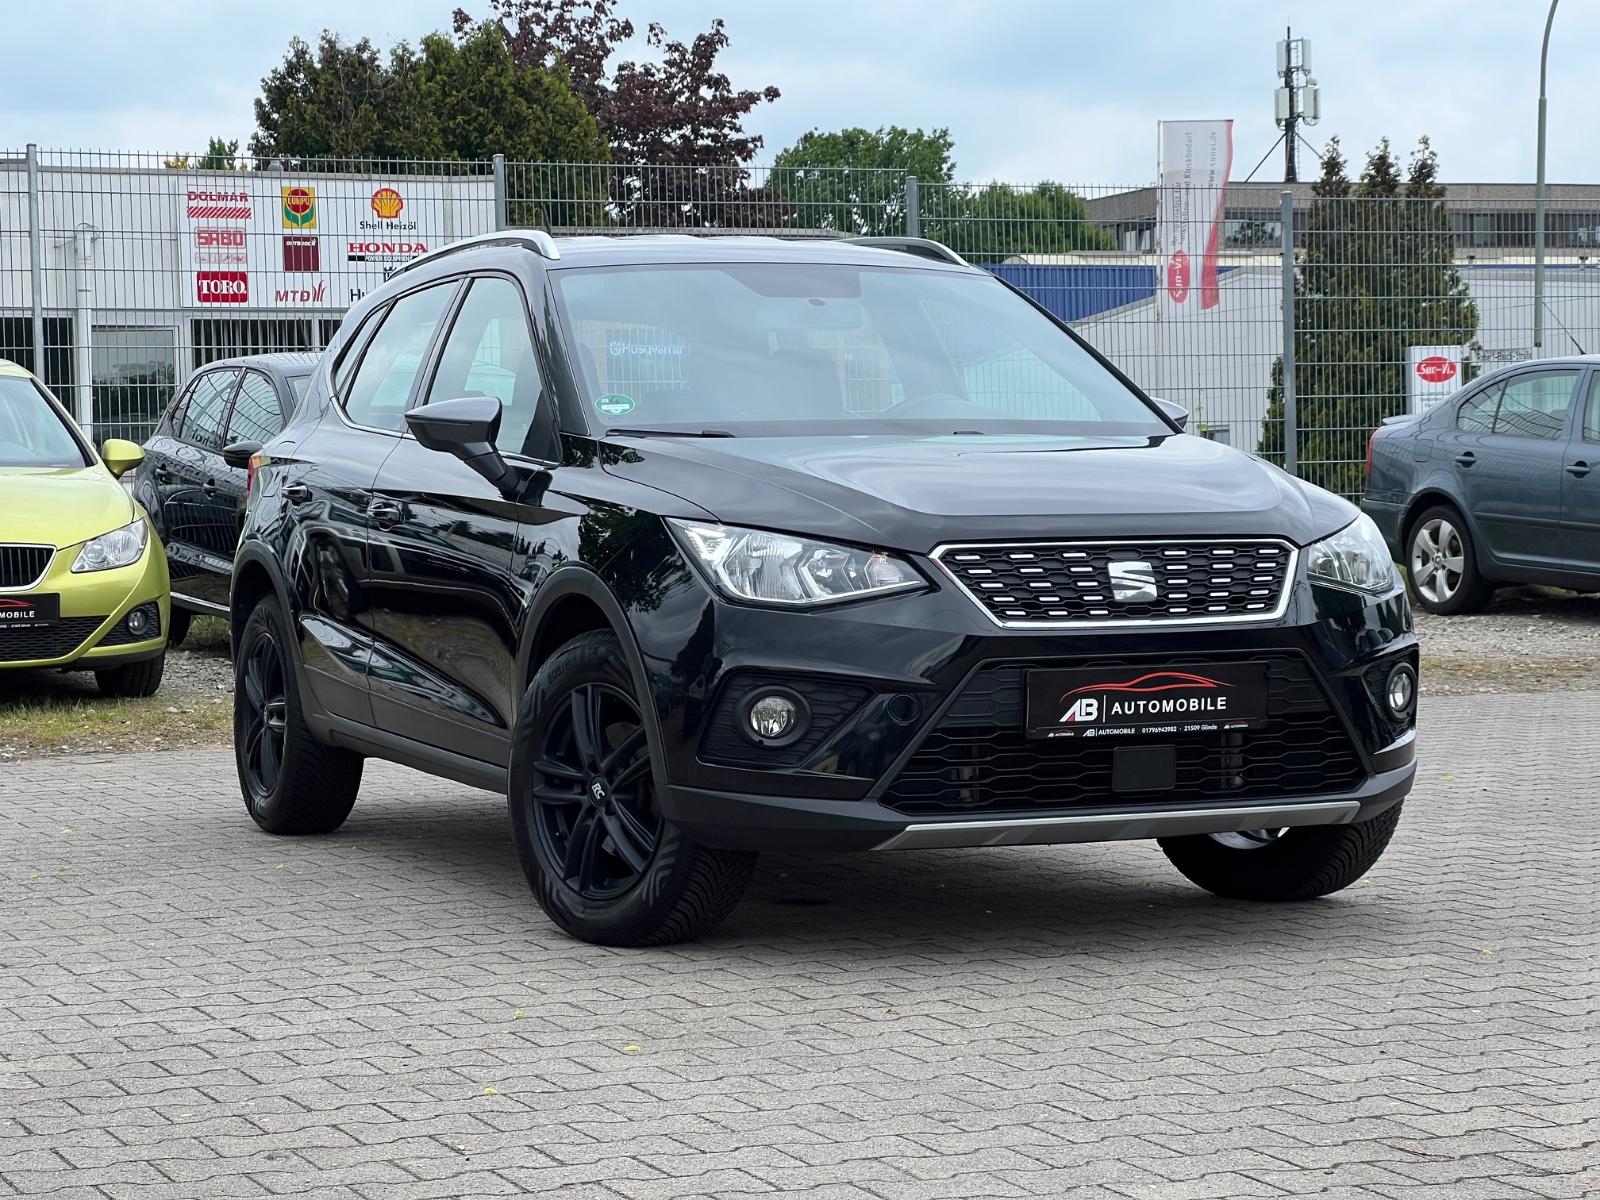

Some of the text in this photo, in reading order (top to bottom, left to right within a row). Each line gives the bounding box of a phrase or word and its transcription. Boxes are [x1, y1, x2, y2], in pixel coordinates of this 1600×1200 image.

[1184, 131, 1193, 179] Kioskbedarf
[187, 191, 248, 202] DOLMAR
[360, 221, 416, 230] Shell Heizöl
[197, 229, 243, 246] SABO
[348, 243, 428, 253] HONDA
[199, 279, 245, 294] TORO
[275, 290, 310, 302] MTD
[1059, 696, 1227, 722] AB AUTOMOBILE
[1083, 729, 1095, 737] AB
[1098, 728, 1136, 736] AUTOMOBILE
